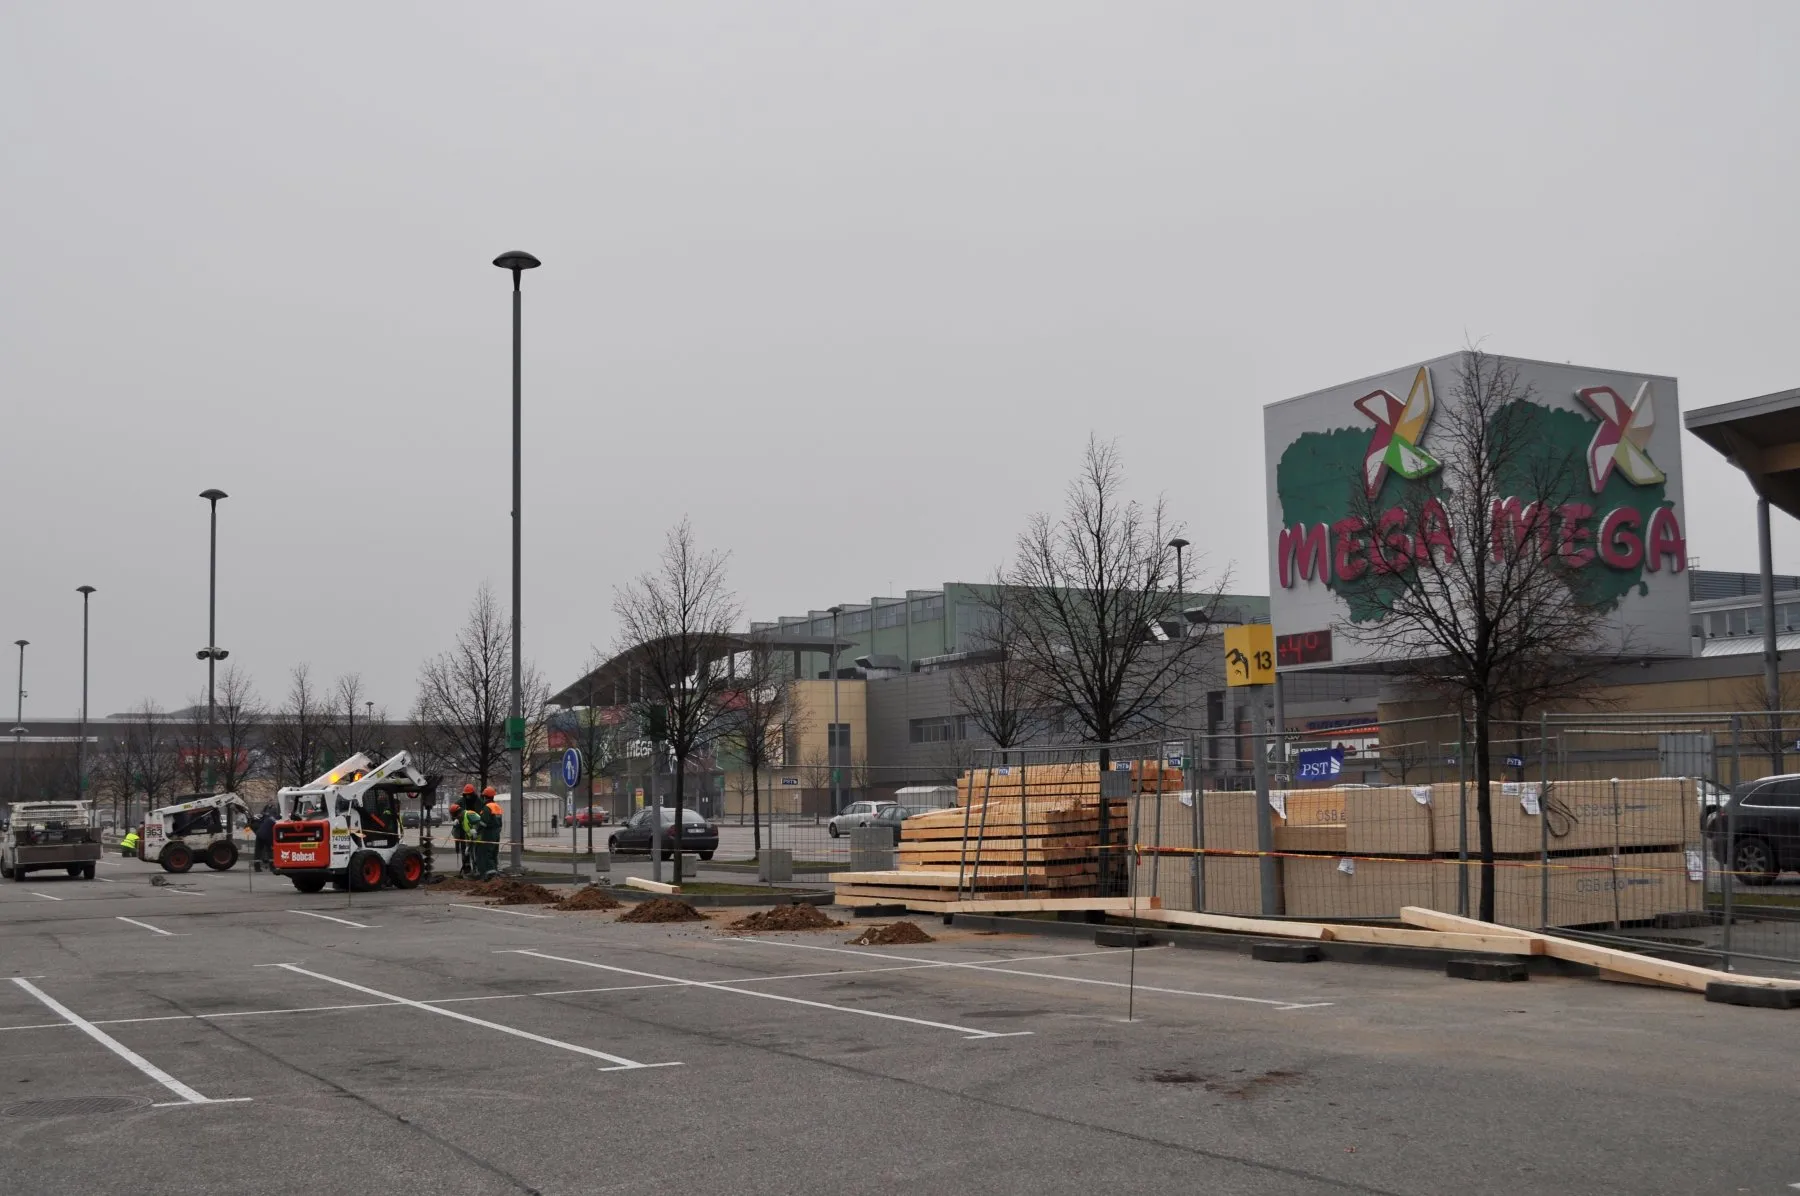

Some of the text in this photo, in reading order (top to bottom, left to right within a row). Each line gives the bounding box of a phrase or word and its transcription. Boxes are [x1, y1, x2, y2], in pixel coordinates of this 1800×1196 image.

[1278, 497, 1456, 588] MEGA
[1489, 496, 1686, 574] MEGA
[1254, 650, 1272, 670] 13
[1301, 761, 1328, 776] PST
[146, 828, 162, 836] 963
[291, 852, 316, 862] Bobcat
